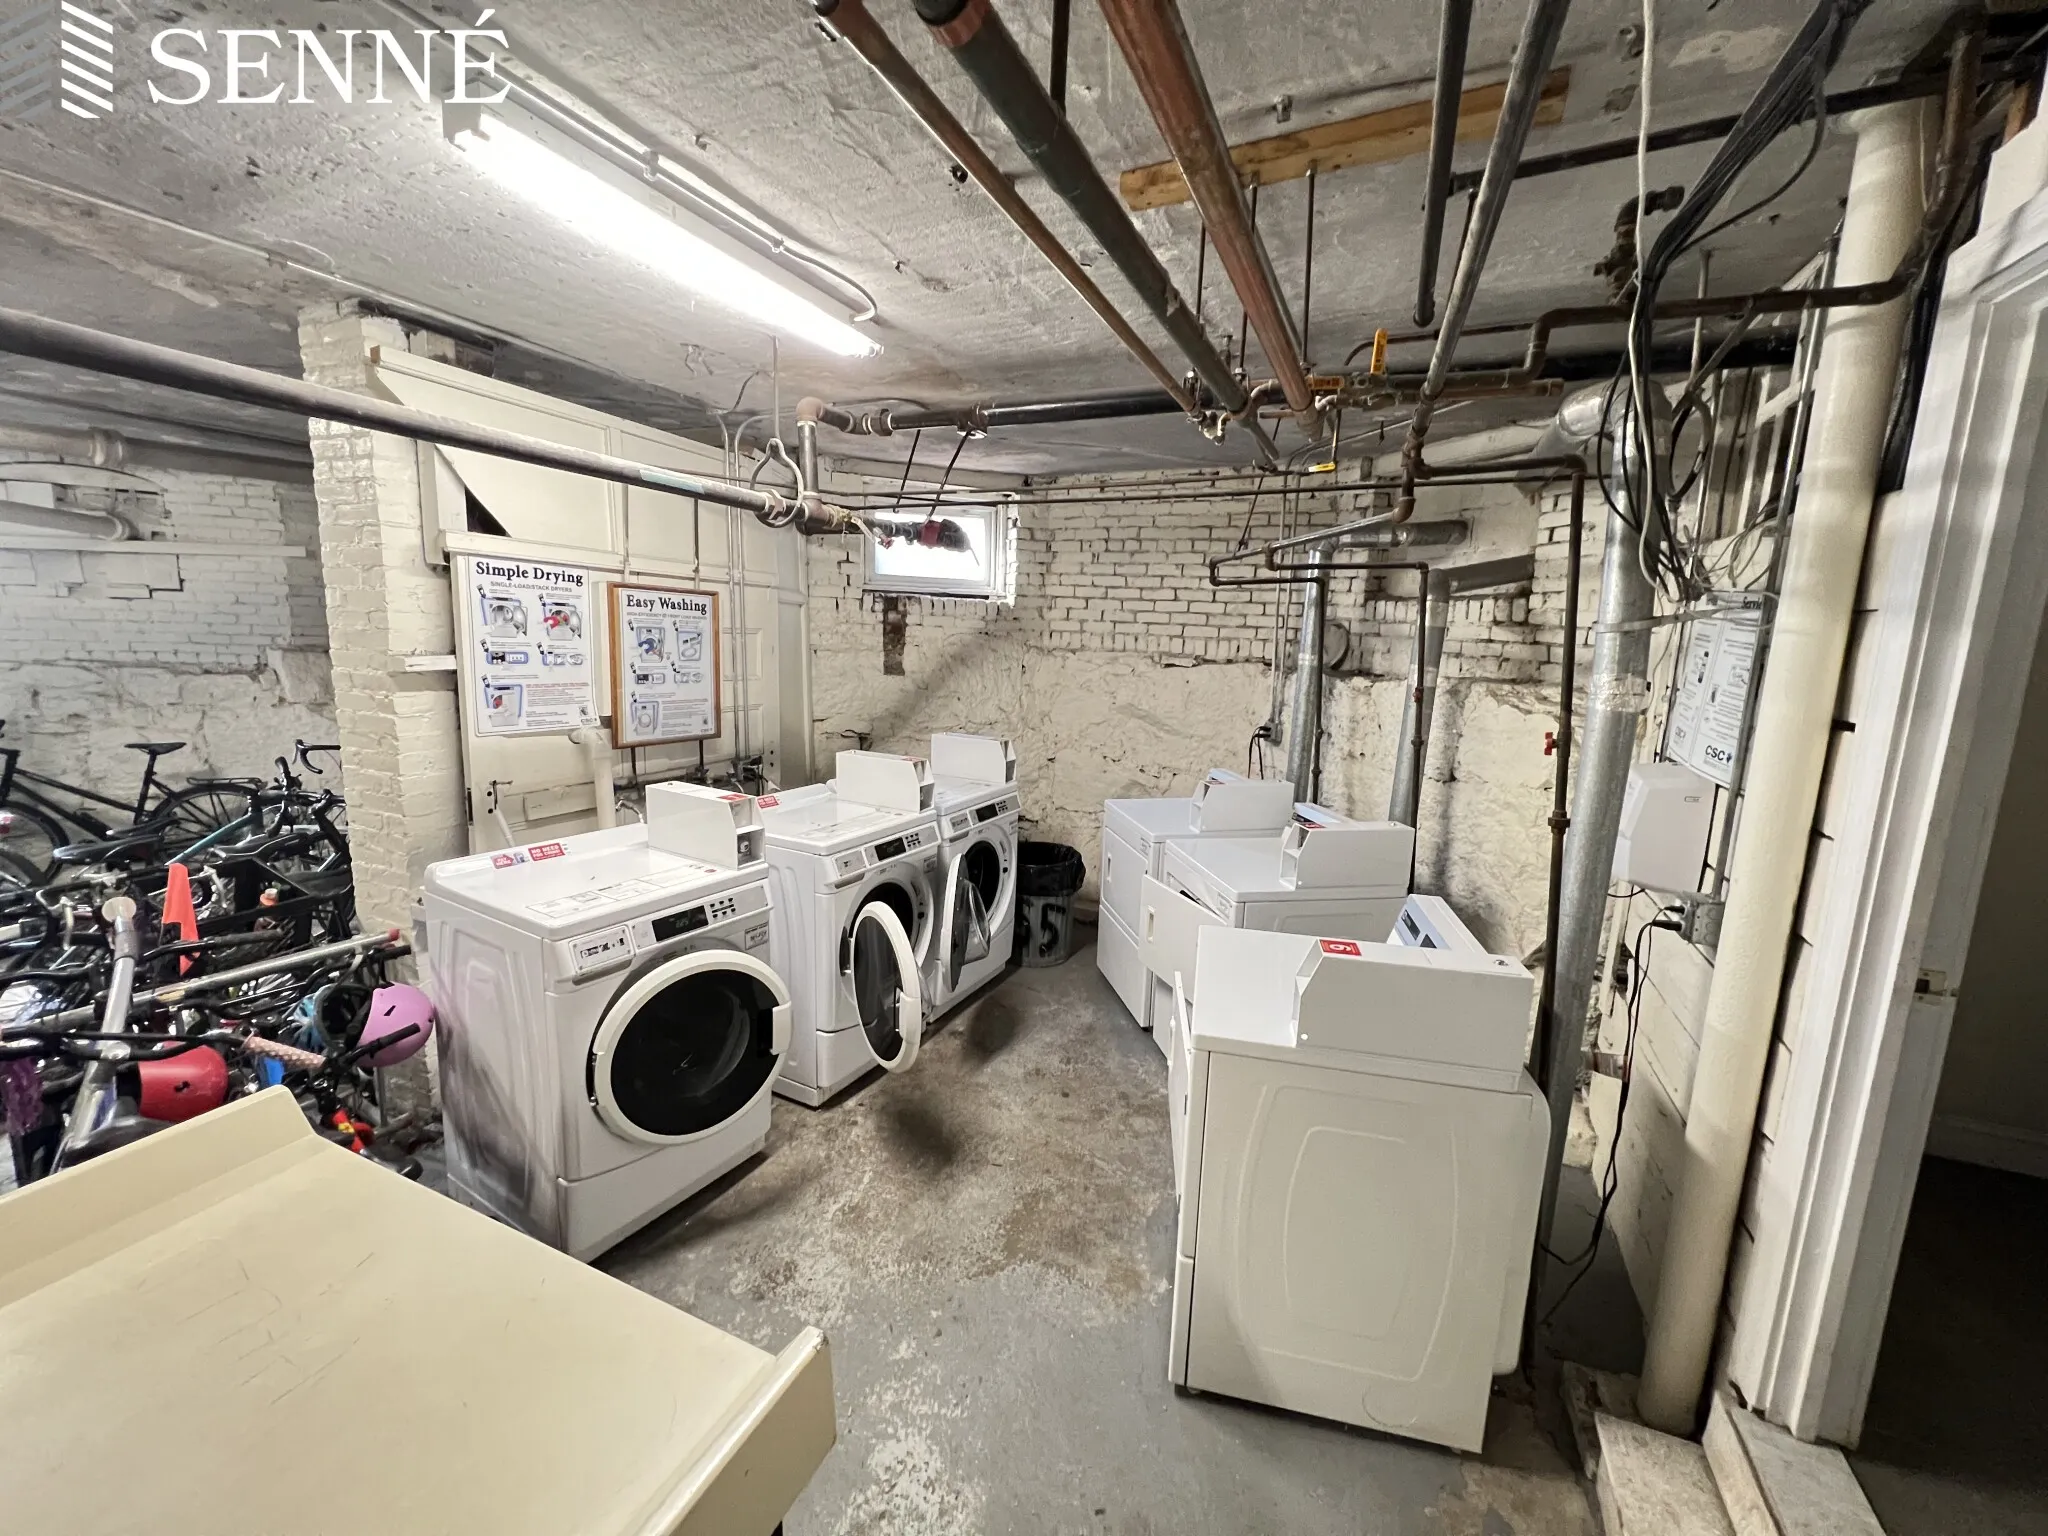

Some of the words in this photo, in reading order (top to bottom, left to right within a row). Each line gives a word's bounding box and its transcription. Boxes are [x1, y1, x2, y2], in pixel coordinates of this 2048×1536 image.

[476, 561, 529, 580] Simple
[533, 567, 583, 587] Drying
[626, 595, 655, 612] Easy
[658, 597, 707, 615] Washing
[1705, 745, 1725, 761] CSC
